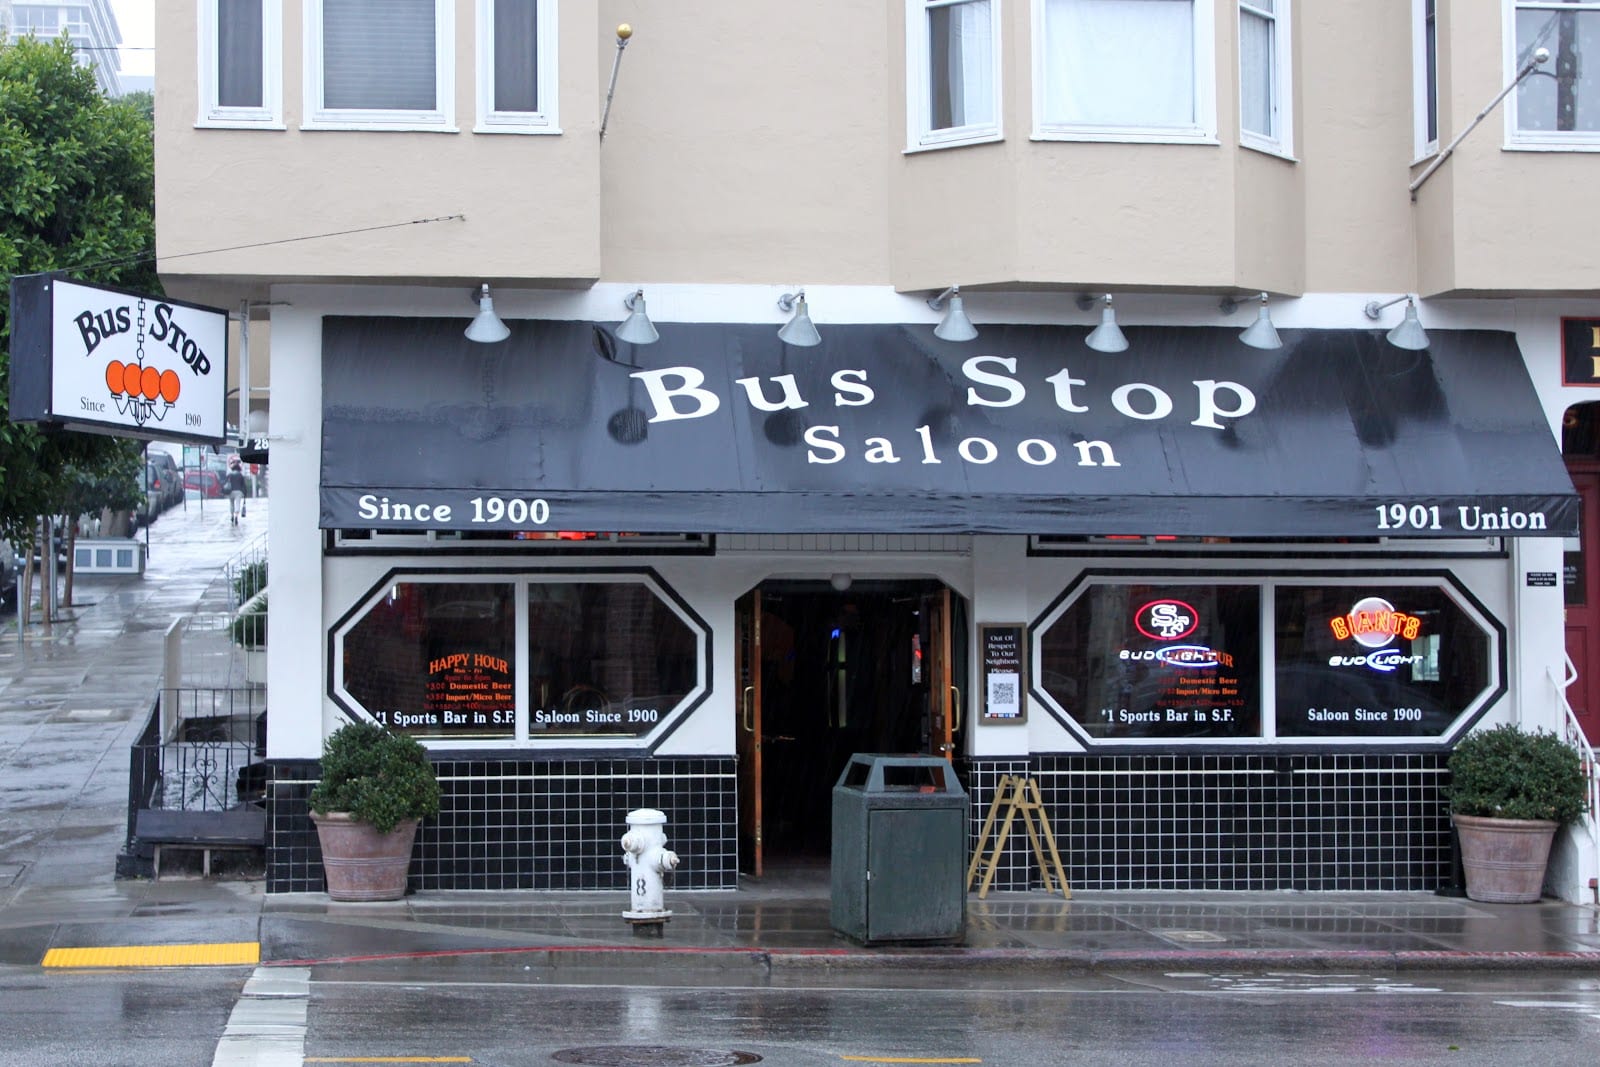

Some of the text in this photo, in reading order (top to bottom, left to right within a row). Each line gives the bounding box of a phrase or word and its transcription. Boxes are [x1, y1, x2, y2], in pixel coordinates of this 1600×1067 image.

[630, 355, 1256, 430] Bus Stop
[80, 396, 201, 427] Since 1900
[803, 424, 1121, 467] Saloon
[358, 494, 550, 524] Since 1900
[1376, 503, 1547, 531] 1901 Union
[1331, 610, 1420, 640] GIANTS
[1119, 649, 1156, 660] BUD
[1328, 655, 1423, 666] BUD LIGHT
[429, 653, 508, 675] HAPPY HOUR
[449, 682, 489, 690] Domestic
[491, 681, 512, 690] Beer
[445, 693, 493, 702] Import/Micro
[495, 692, 512, 700] Beer
[393, 710, 438, 727] Sports
[443, 710, 468, 724] Bar
[474, 711, 487, 723] in
[492, 710, 515, 724] S.F.
[535, 709, 658, 724] Saloon Since 1900
[1119, 708, 1160, 725] Sports
[1166, 708, 1188, 722] Bar
[1194, 709, 1207, 721] in
[1211, 708, 1235, 722] S.F.
[1307, 707, 1422, 721] Saloon Since 1900
[636, 878, 646, 896] 8
